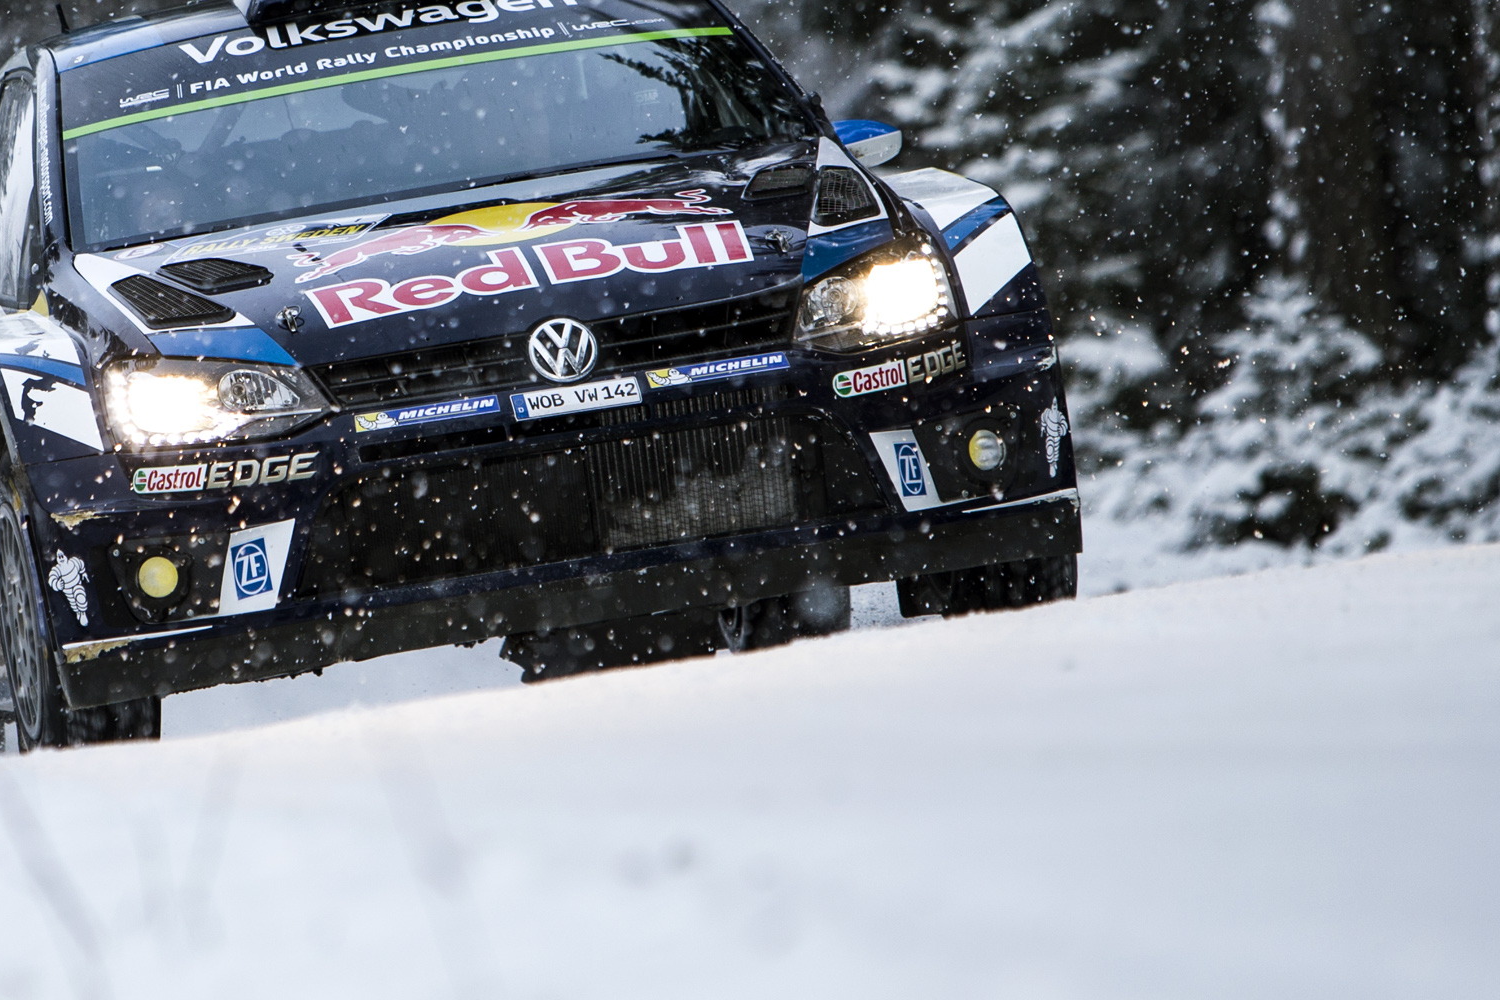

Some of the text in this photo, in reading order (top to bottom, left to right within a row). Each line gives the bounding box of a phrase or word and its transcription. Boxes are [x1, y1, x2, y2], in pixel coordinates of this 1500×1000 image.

[120, 88, 170, 108] WRC
[190, 77, 231, 95] FIA
[236, 62, 309, 85] World
[316, 52, 377, 72] Rally
[385, 24, 556, 59] Championship
[184, 238, 256, 257] RALLY
[259, 223, 365, 245] SWEDEN
[308, 221, 752, 328] Red Bull
[690, 354, 783, 376] MICHELIN
[853, 342, 967, 393] Castrol EDGE
[399, 399, 495, 420] MICHELIN
[527, 382, 638, 411] WOB VW 142
[147, 451, 320, 492] Castrol EDGE
[900, 455, 923, 485] ZF
[237, 551, 267, 587] ZF
